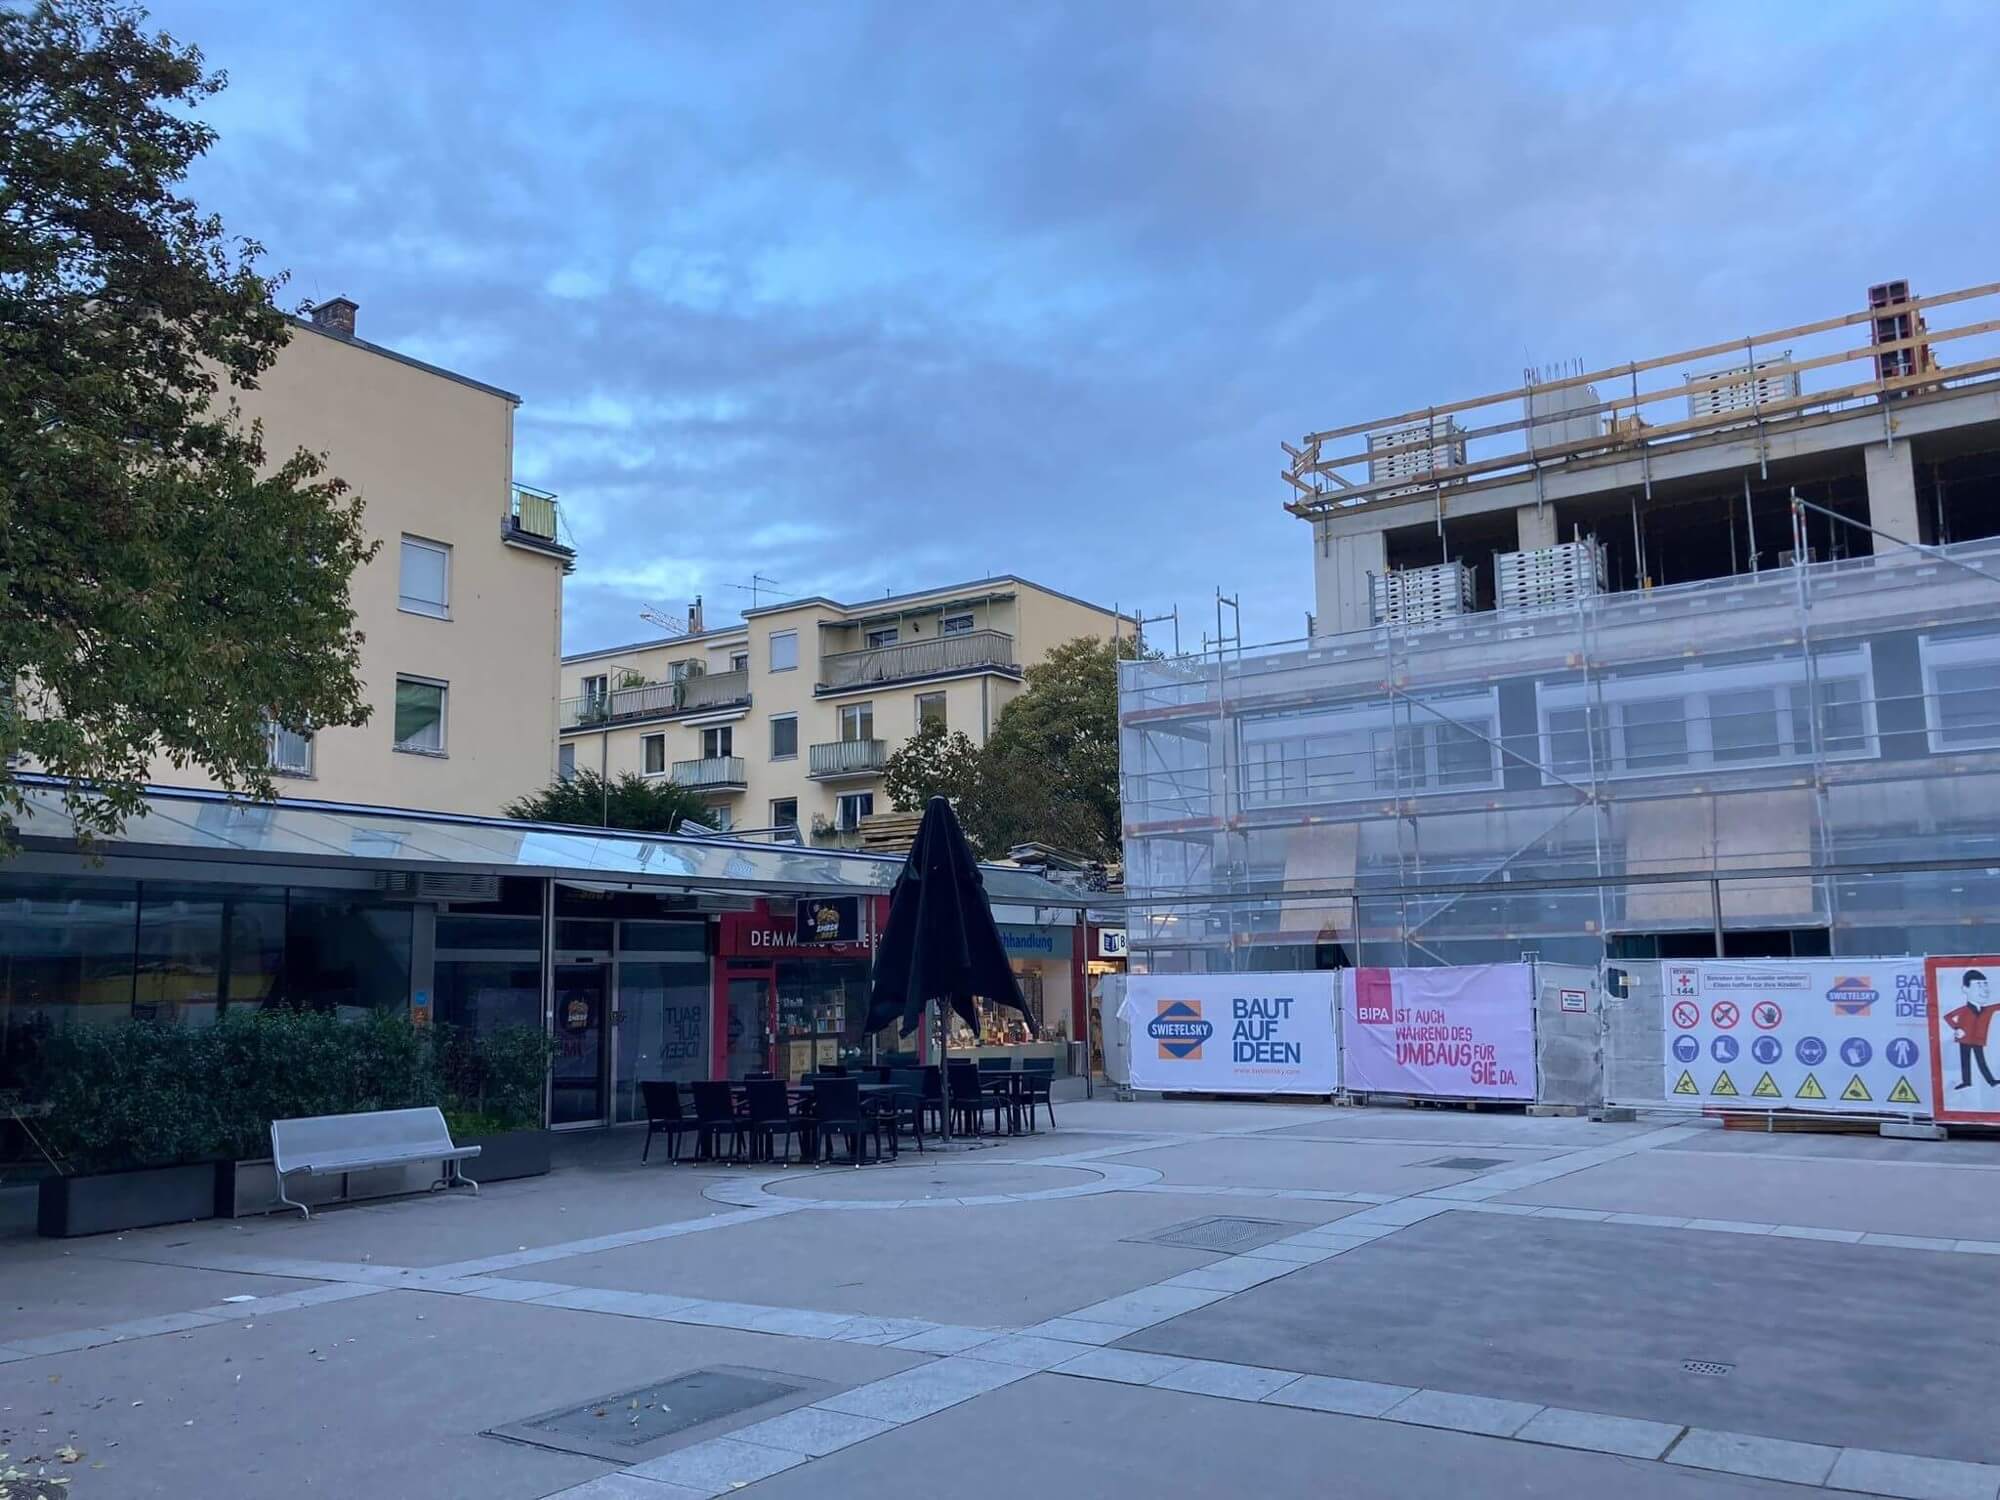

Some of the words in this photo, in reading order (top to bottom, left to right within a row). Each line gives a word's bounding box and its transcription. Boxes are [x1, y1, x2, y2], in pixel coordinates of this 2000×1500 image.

[1233, 998, 1294, 1019] BAUT
[1359, 1007, 1390, 1020] BIPA
[1395, 1008, 1411, 1023] IST
[1415, 1010, 1445, 1024] AUCH
[1151, 1023, 1209, 1036] SWIETELSKY
[1232, 1020, 1278, 1041] AUF
[1451, 1027, 1473, 1042] DES
[1233, 1042, 1301, 1064] IDEEN
[1396, 1042, 1473, 1066] UMBAUS
[1473, 1043, 1495, 1061] FÜR
[1471, 1061, 1497, 1085] SIE
